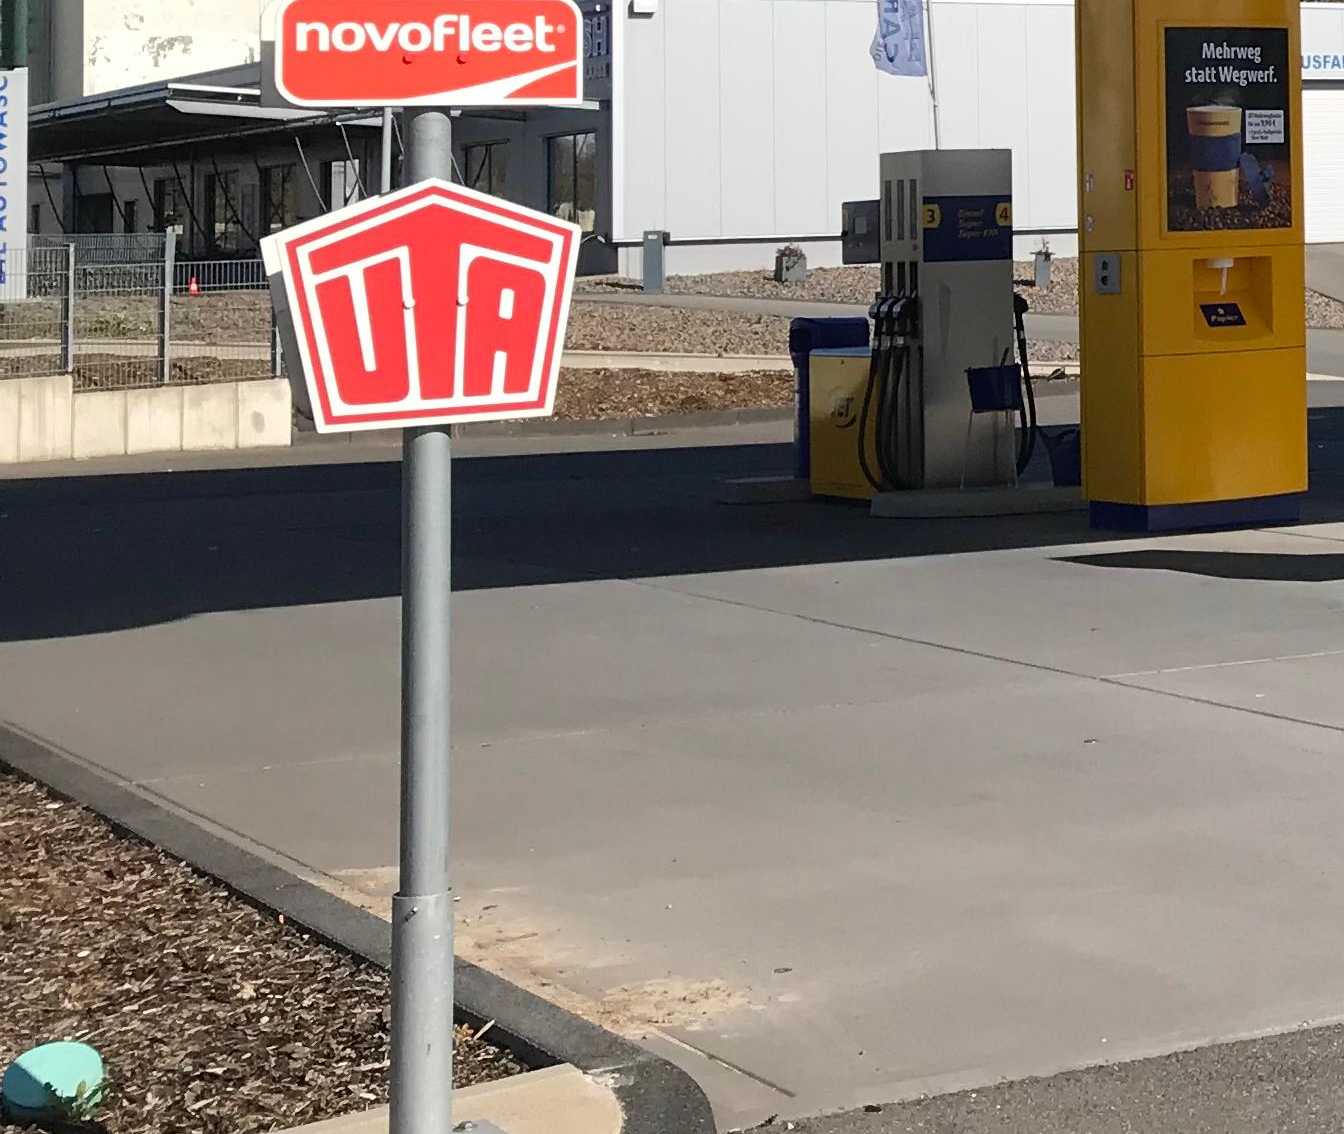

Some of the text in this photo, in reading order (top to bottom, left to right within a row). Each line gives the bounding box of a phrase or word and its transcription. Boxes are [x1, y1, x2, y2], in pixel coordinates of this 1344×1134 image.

[295, 14, 556, 53] novofleet
[1202, 42, 1261, 64] Mehrweg
[1185, 65, 1278, 87] statt Wegwerf.
[926, 209, 936, 224] 3
[999, 207, 1010, 222] 4
[309, 202, 556, 407] UTA
